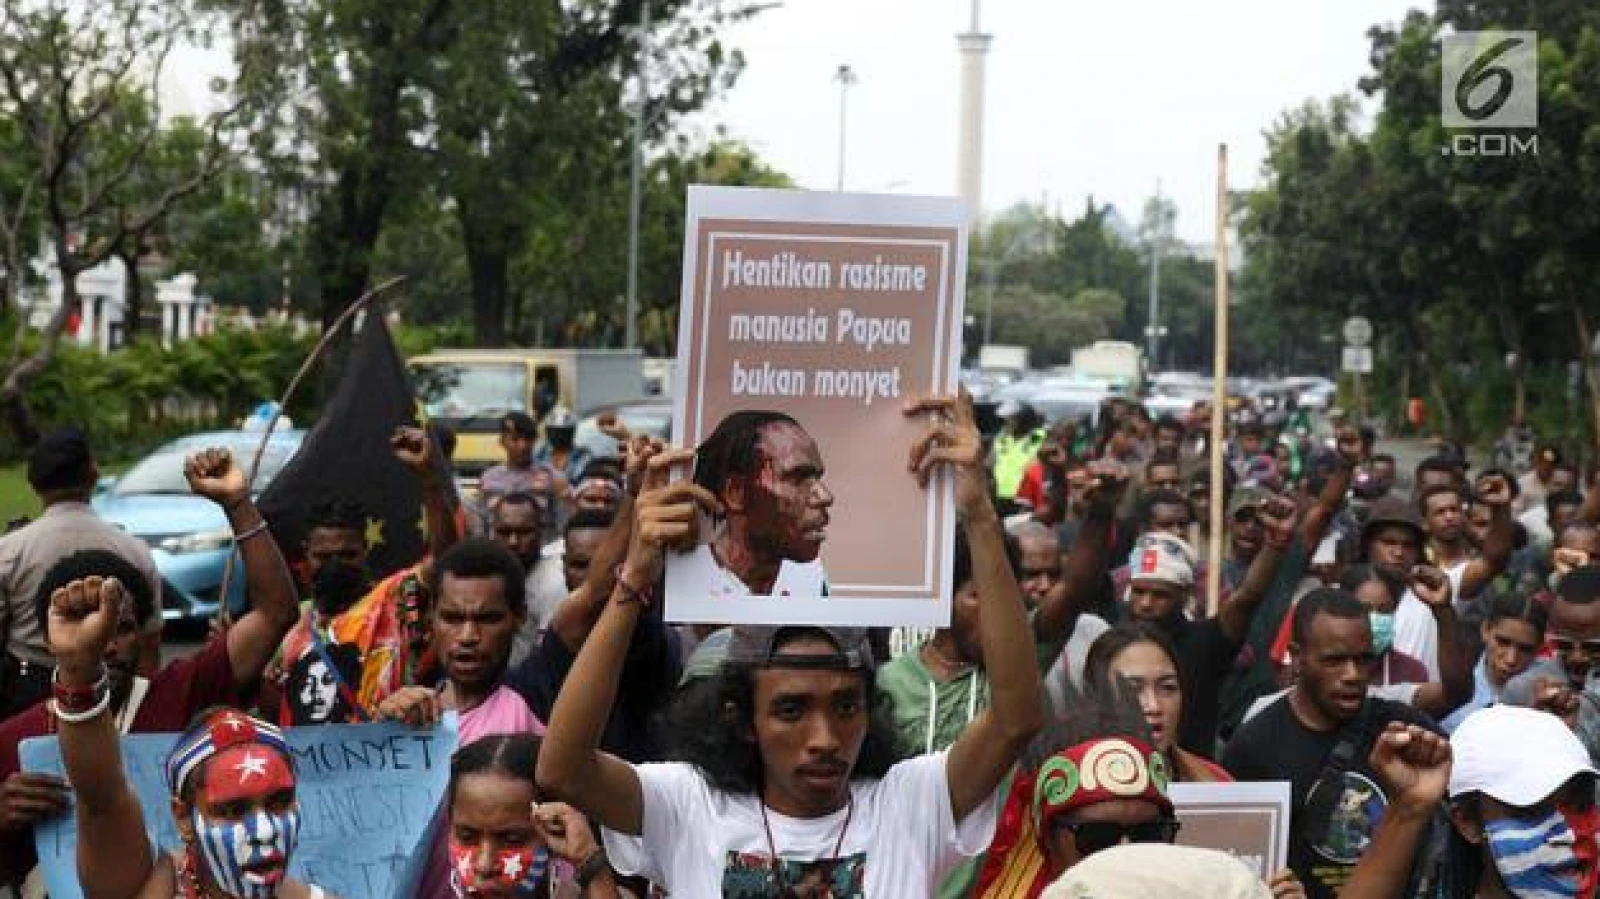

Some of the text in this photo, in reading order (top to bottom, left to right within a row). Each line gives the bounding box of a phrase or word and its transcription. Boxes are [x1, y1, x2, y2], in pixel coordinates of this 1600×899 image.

[723, 249, 926, 291] Hentikan rasisme
[728, 308, 912, 351] manusia Papua
[731, 359, 901, 405] bukan monyet
[290, 735, 434, 773] MONYET
